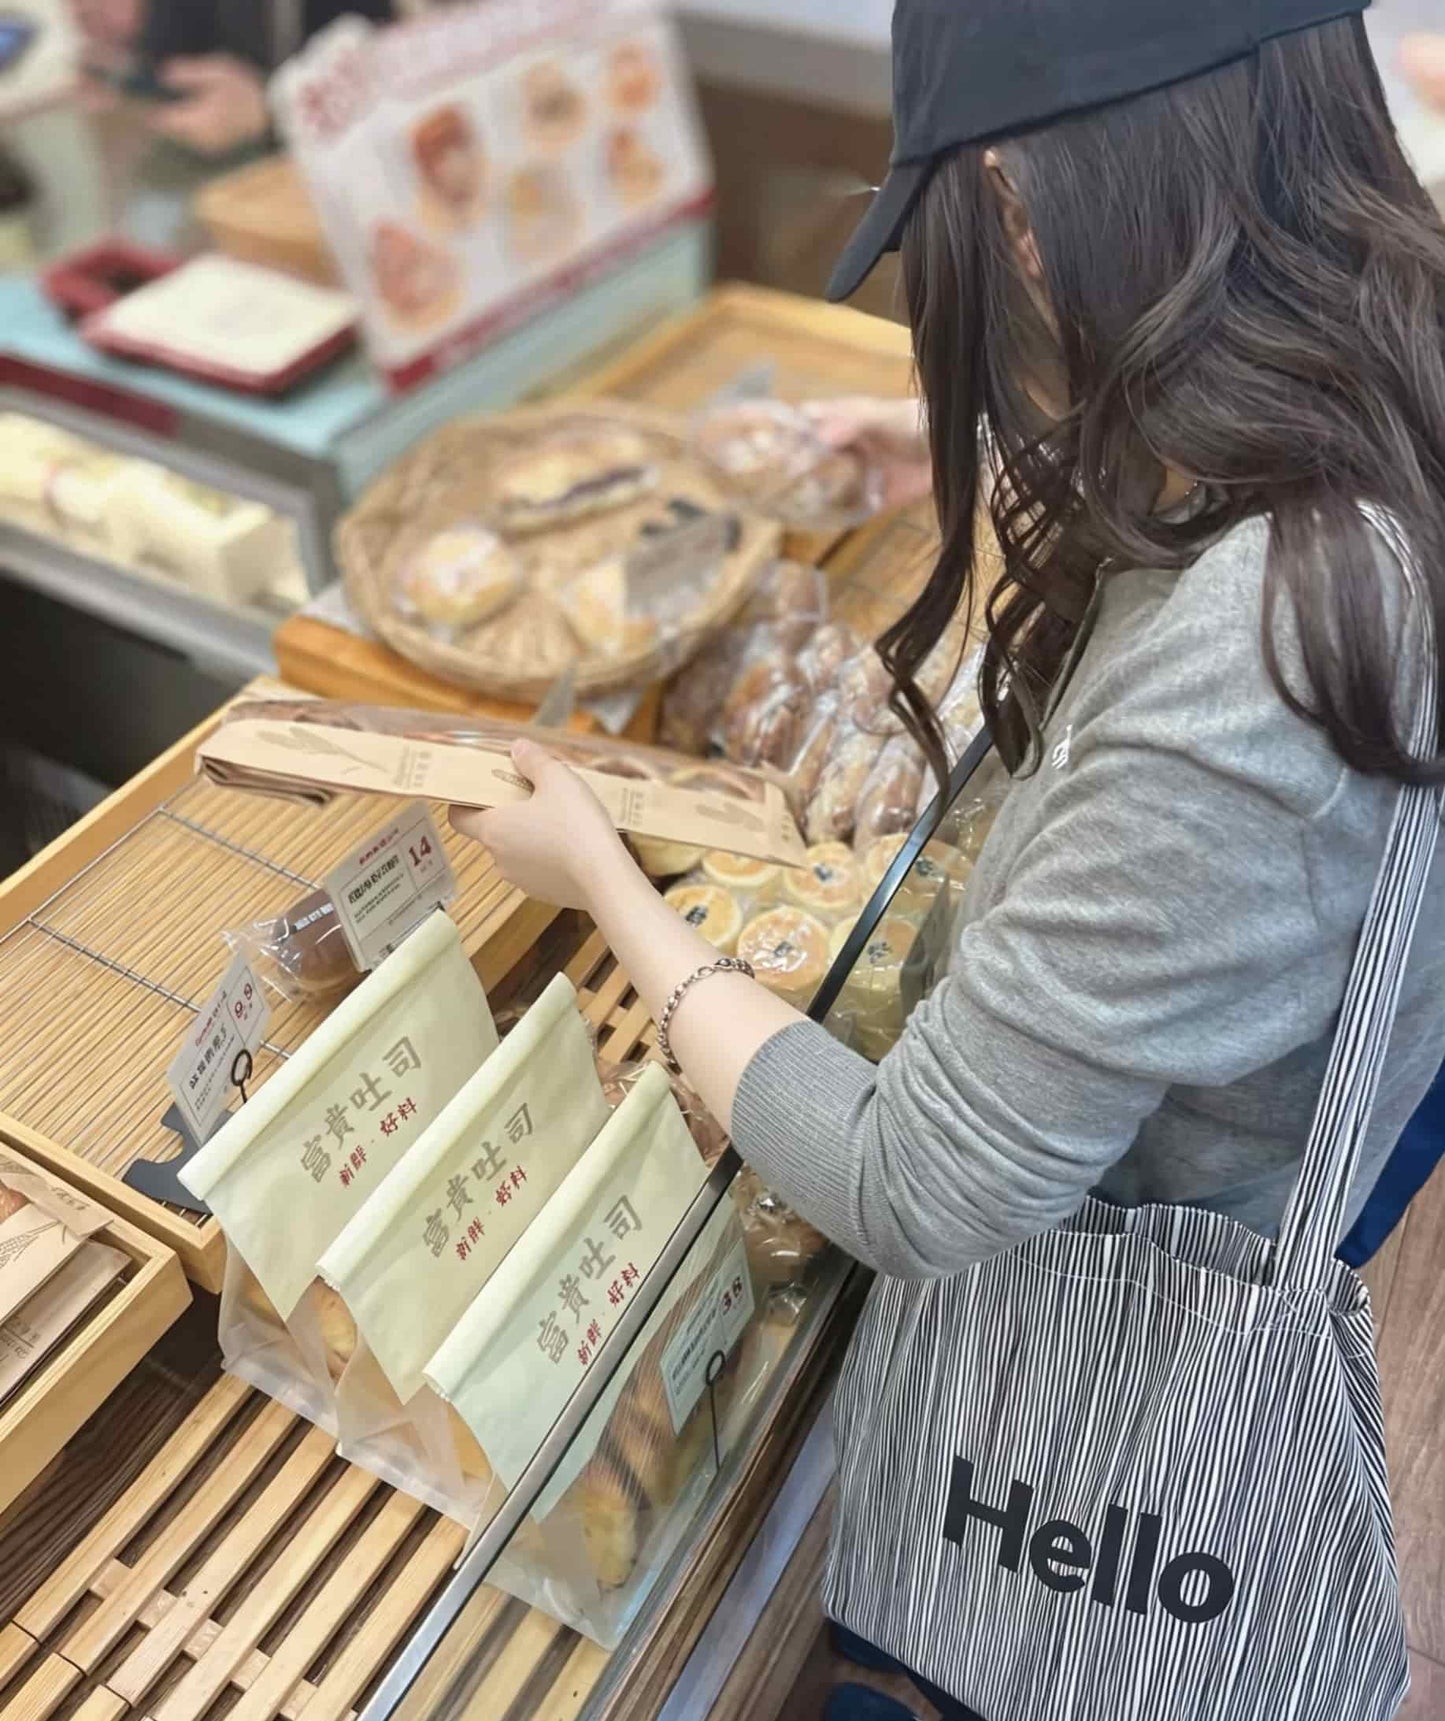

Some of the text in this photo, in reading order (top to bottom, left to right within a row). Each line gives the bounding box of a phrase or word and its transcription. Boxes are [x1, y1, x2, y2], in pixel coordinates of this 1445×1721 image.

[407, 835, 433, 868] 14
[300, 1036, 422, 1184] 富貴吐司
[421, 1102, 535, 1258] 富貴吐司
[536, 1195, 644, 1366] 富貴吐司
[942, 1454, 1235, 1624] Hello
